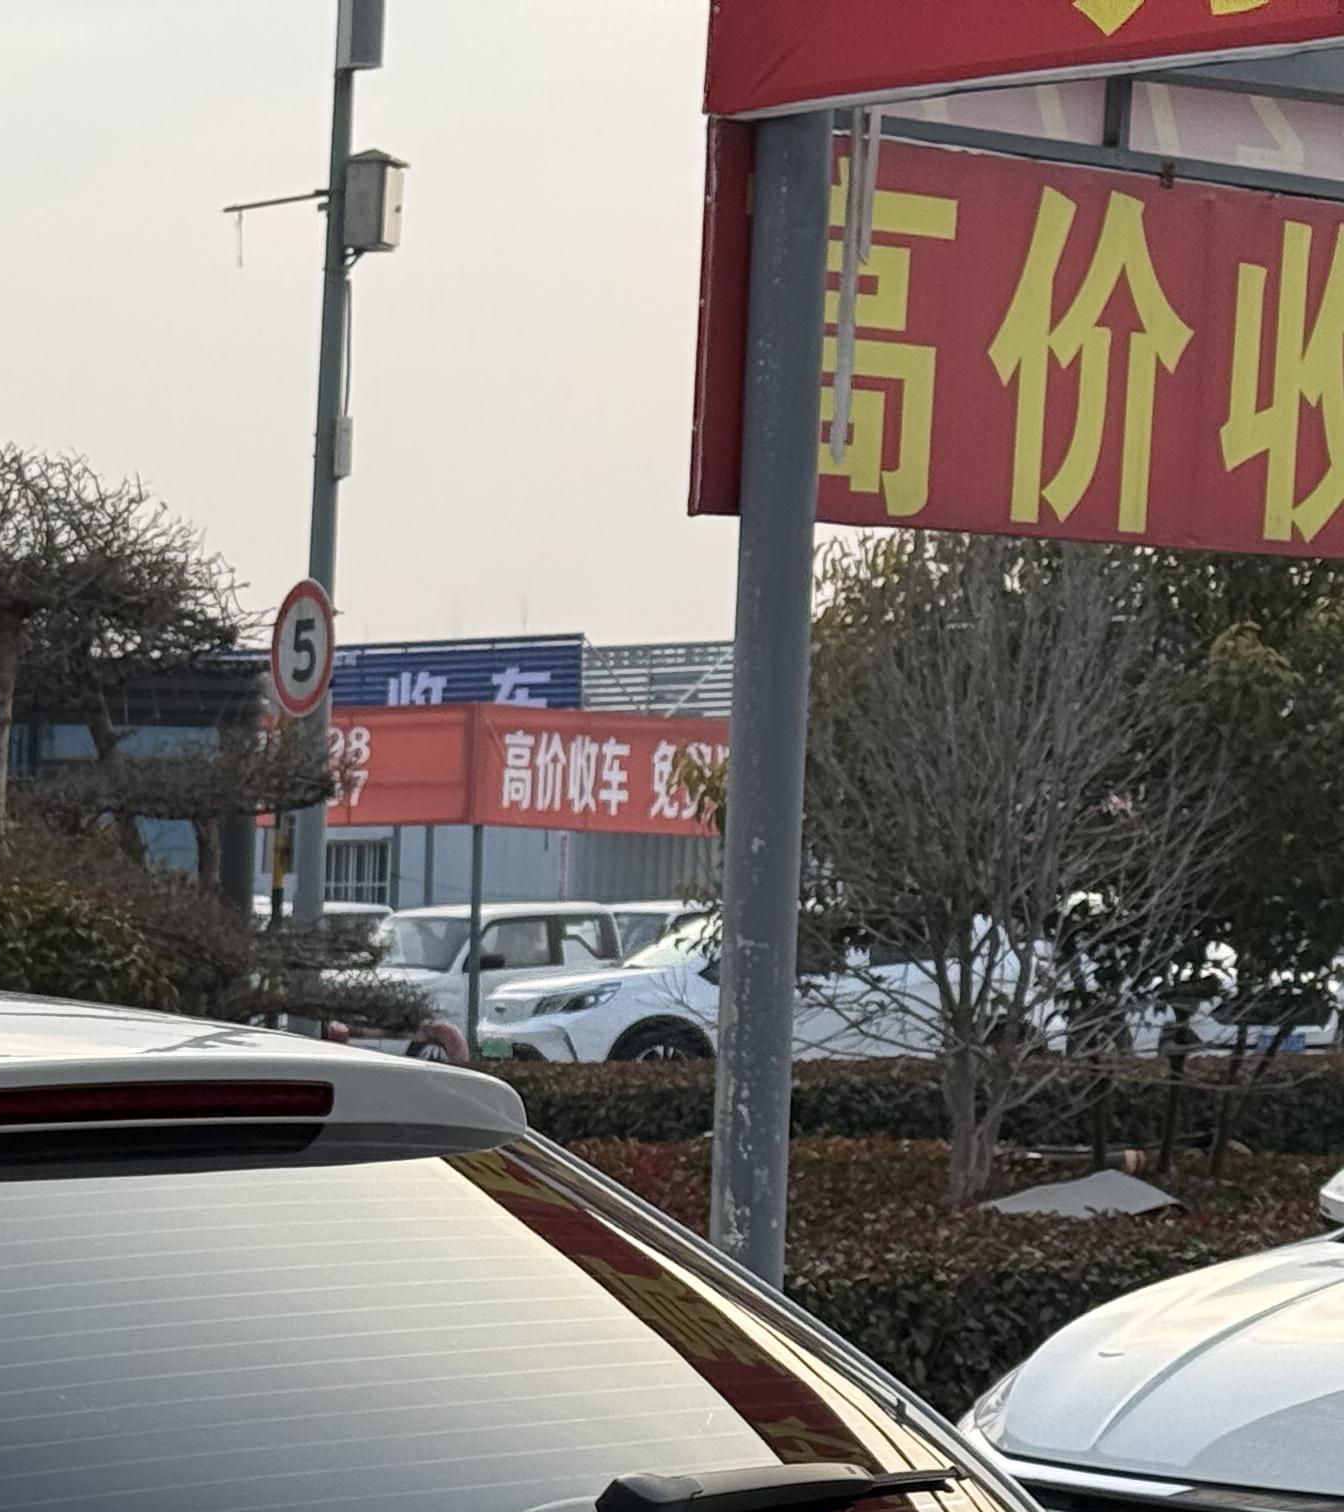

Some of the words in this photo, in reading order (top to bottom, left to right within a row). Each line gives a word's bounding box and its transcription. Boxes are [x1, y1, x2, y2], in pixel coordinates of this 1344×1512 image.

[292, 618, 316, 683] 5
[503, 730, 631, 816] 高价收车
